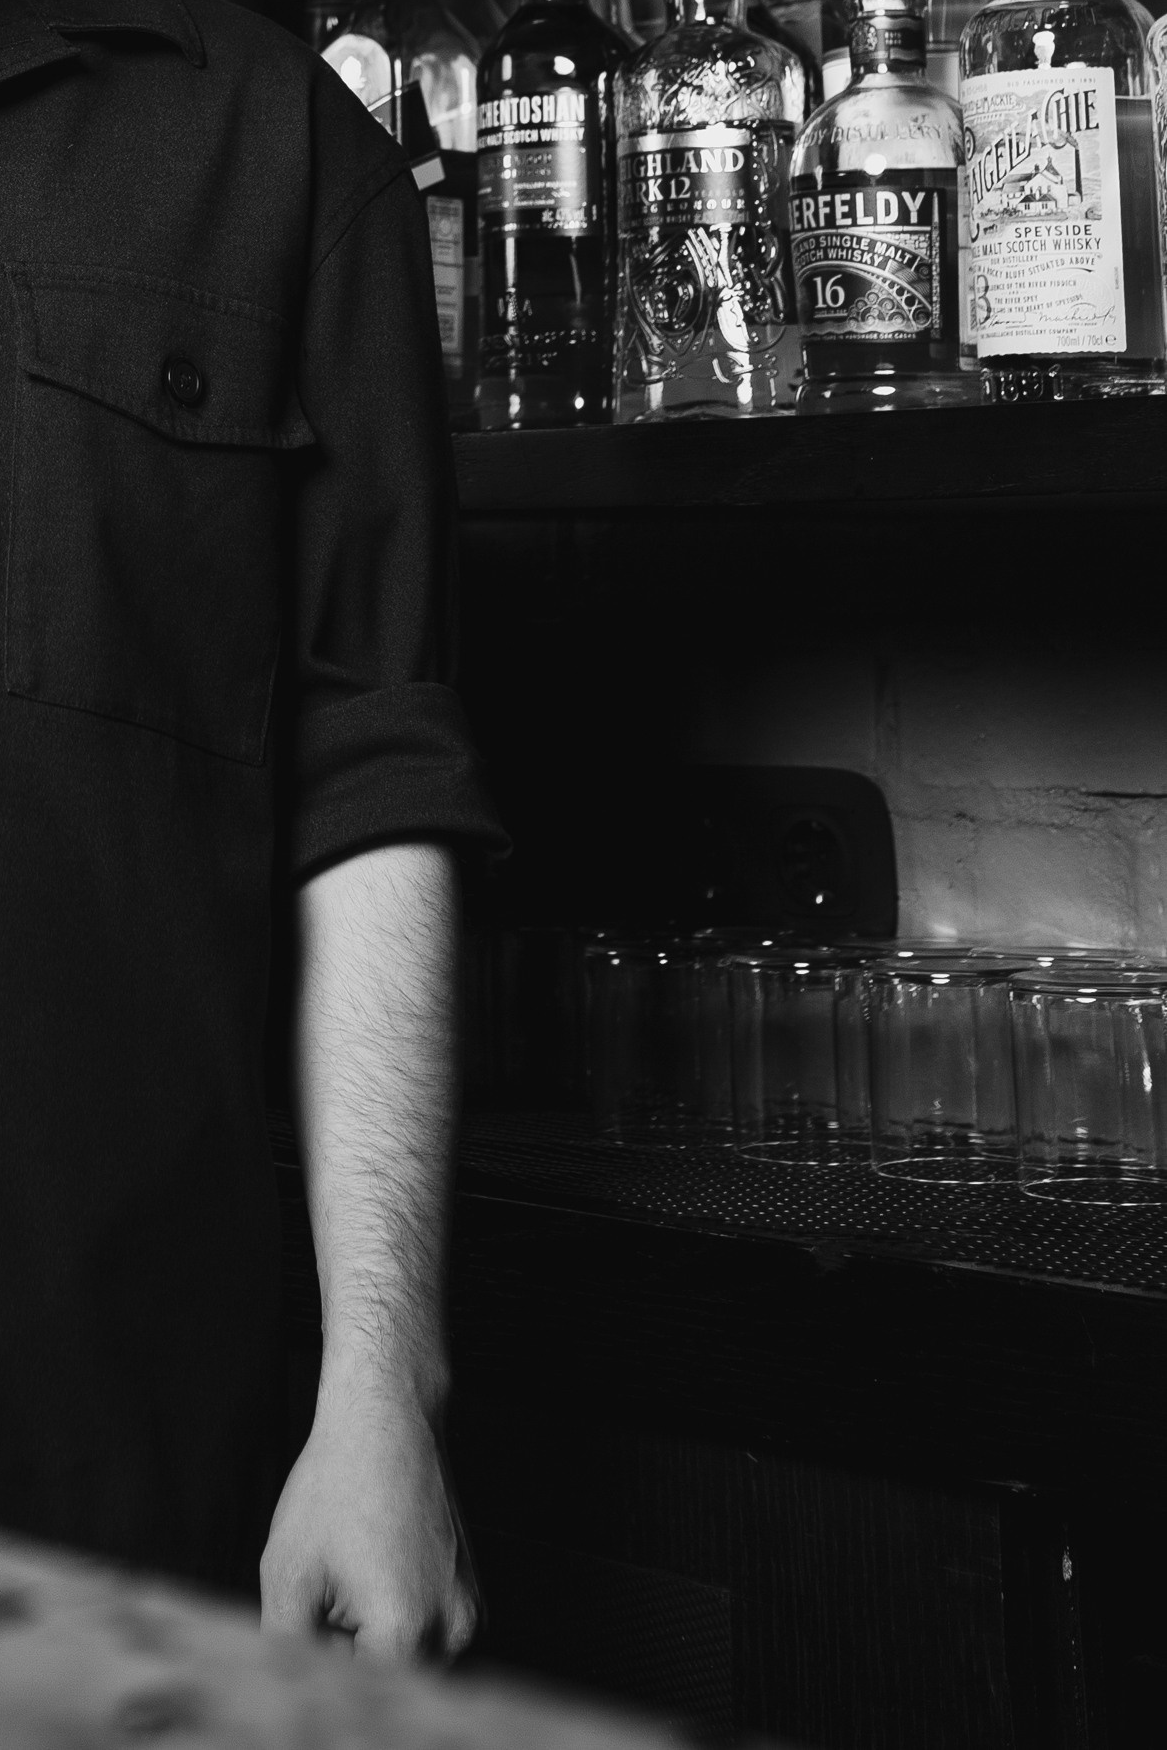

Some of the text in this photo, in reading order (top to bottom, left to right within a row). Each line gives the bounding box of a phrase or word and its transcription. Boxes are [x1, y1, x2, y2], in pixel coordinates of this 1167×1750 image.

[503, 129, 539, 146] SCOTCH
[540, 127, 586, 143] WHISKY
[669, 176, 692, 199] 12
[789, 191, 926, 231] ERFELDY
[1014, 224, 1093, 239] SPEYSIDE
[818, 235, 870, 251] SINGLE
[875, 240, 913, 265] MALT
[982, 237, 1102, 256] MALT SCOTCH WHISKY
[827, 247, 884, 267] WHISKY
[1002, 254, 1039, 264] DISTILLERY
[1005, 268, 1026, 280] BLUFF
[1028, 258, 1066, 276] SITUATED
[1069, 255, 1096, 266] ABOVE
[812, 274, 846, 309] 16
[1028, 280, 1047, 288] RIVER
[1022, 295, 1038, 303] SPEY
[1056, 335, 1081, 347] 700ml
[1087, 335, 1103, 347] 70cl
